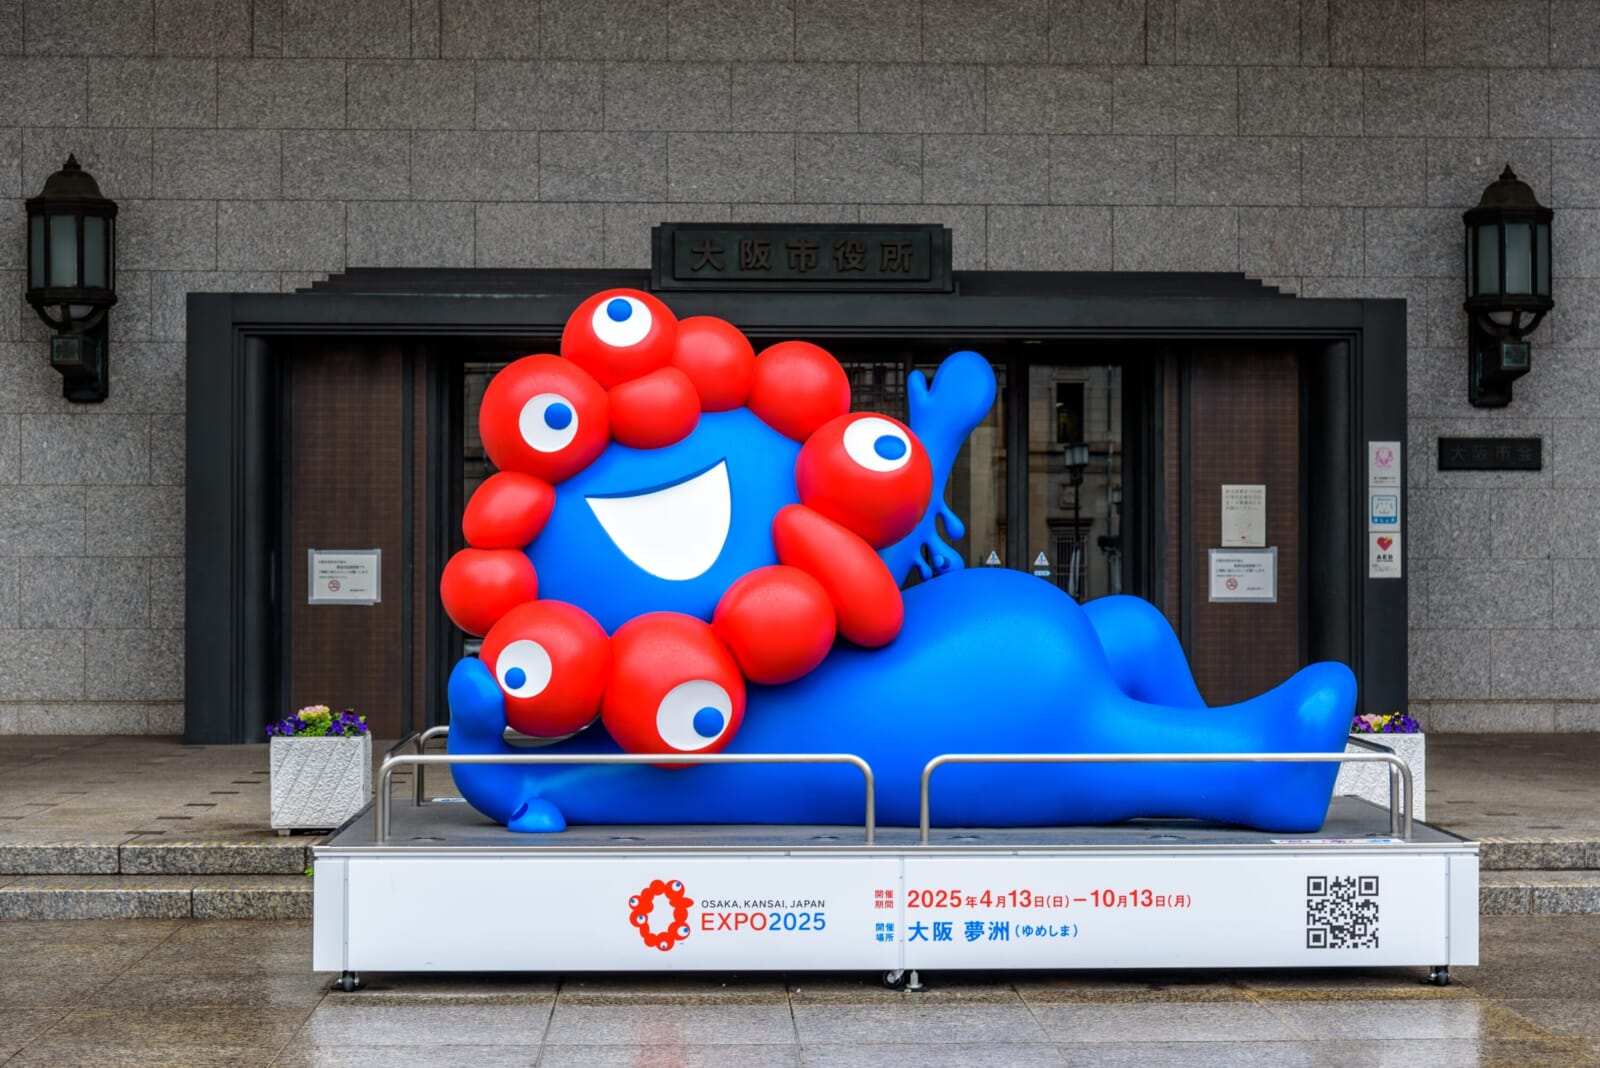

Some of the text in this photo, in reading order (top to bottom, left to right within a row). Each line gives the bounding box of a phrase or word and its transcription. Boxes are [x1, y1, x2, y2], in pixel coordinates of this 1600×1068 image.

[690, 240, 913, 272] 大阪市役所
[874, 889, 894, 899] 開催
[701, 900, 825, 910] OSAKA, KANSAI, JAPAN
[874, 900, 894, 909] 期間
[701, 912, 826, 931] EXPO2025
[875, 922, 895, 932] 開催
[908, 921, 953, 942] 大阪
[875, 933, 895, 942] 場所
